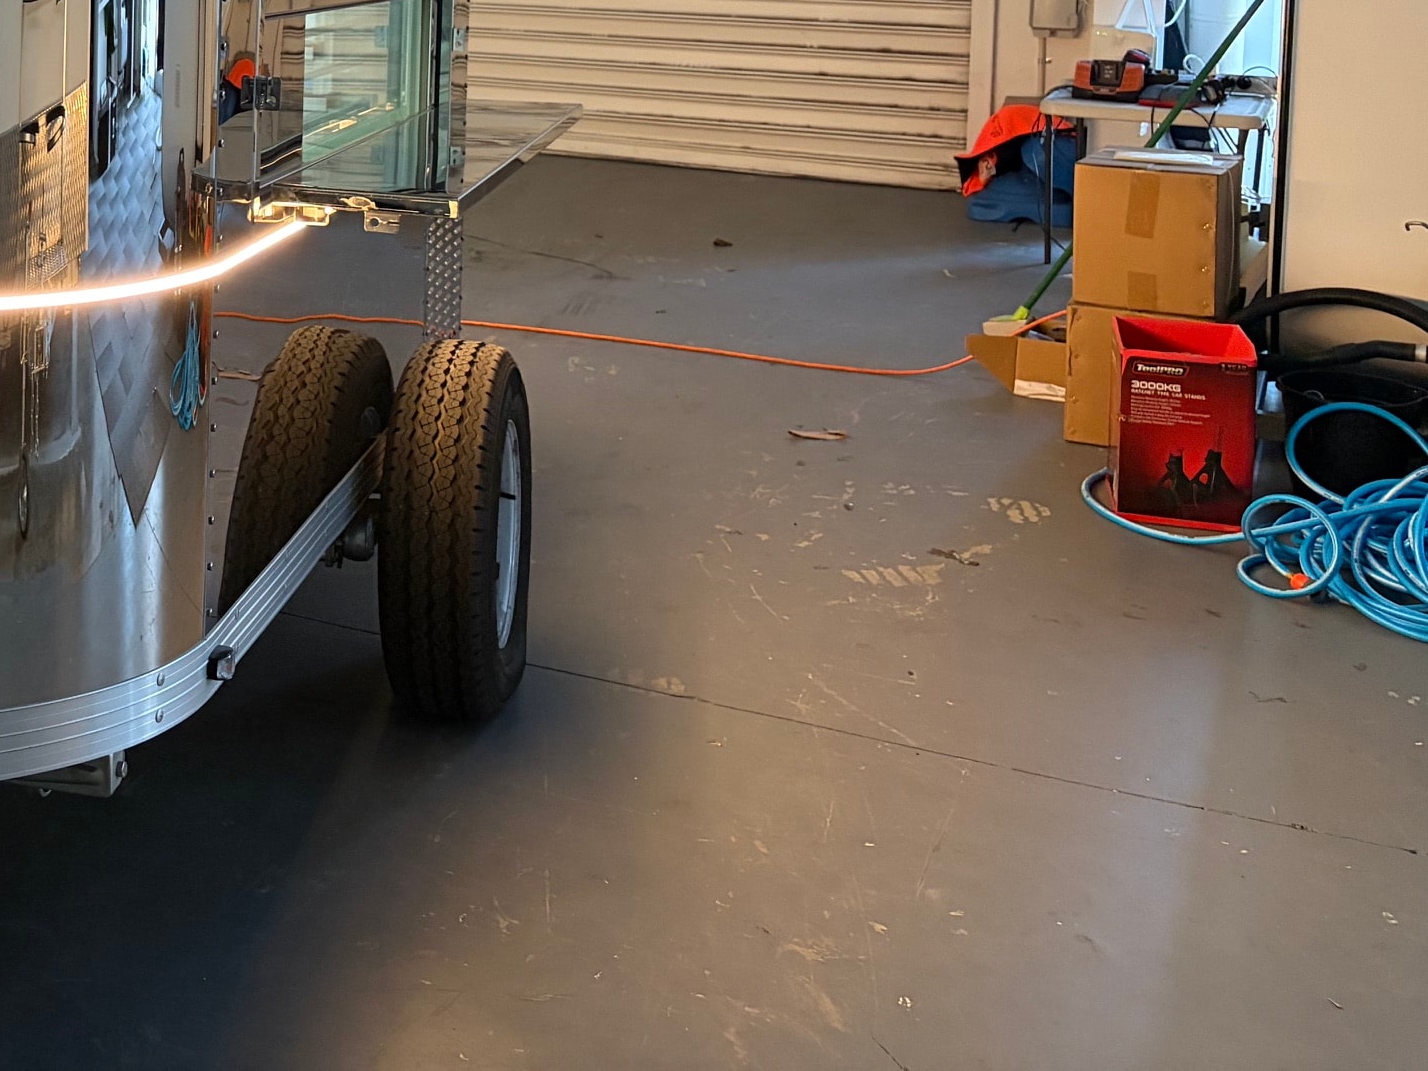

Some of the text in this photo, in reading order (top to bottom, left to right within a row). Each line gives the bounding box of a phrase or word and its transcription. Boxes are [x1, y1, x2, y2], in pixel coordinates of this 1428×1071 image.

[1136, 363, 1184, 376] ToolPRO
[1131, 379, 1181, 392] 3000KG
[1184, 393, 1206, 401] STANDS
